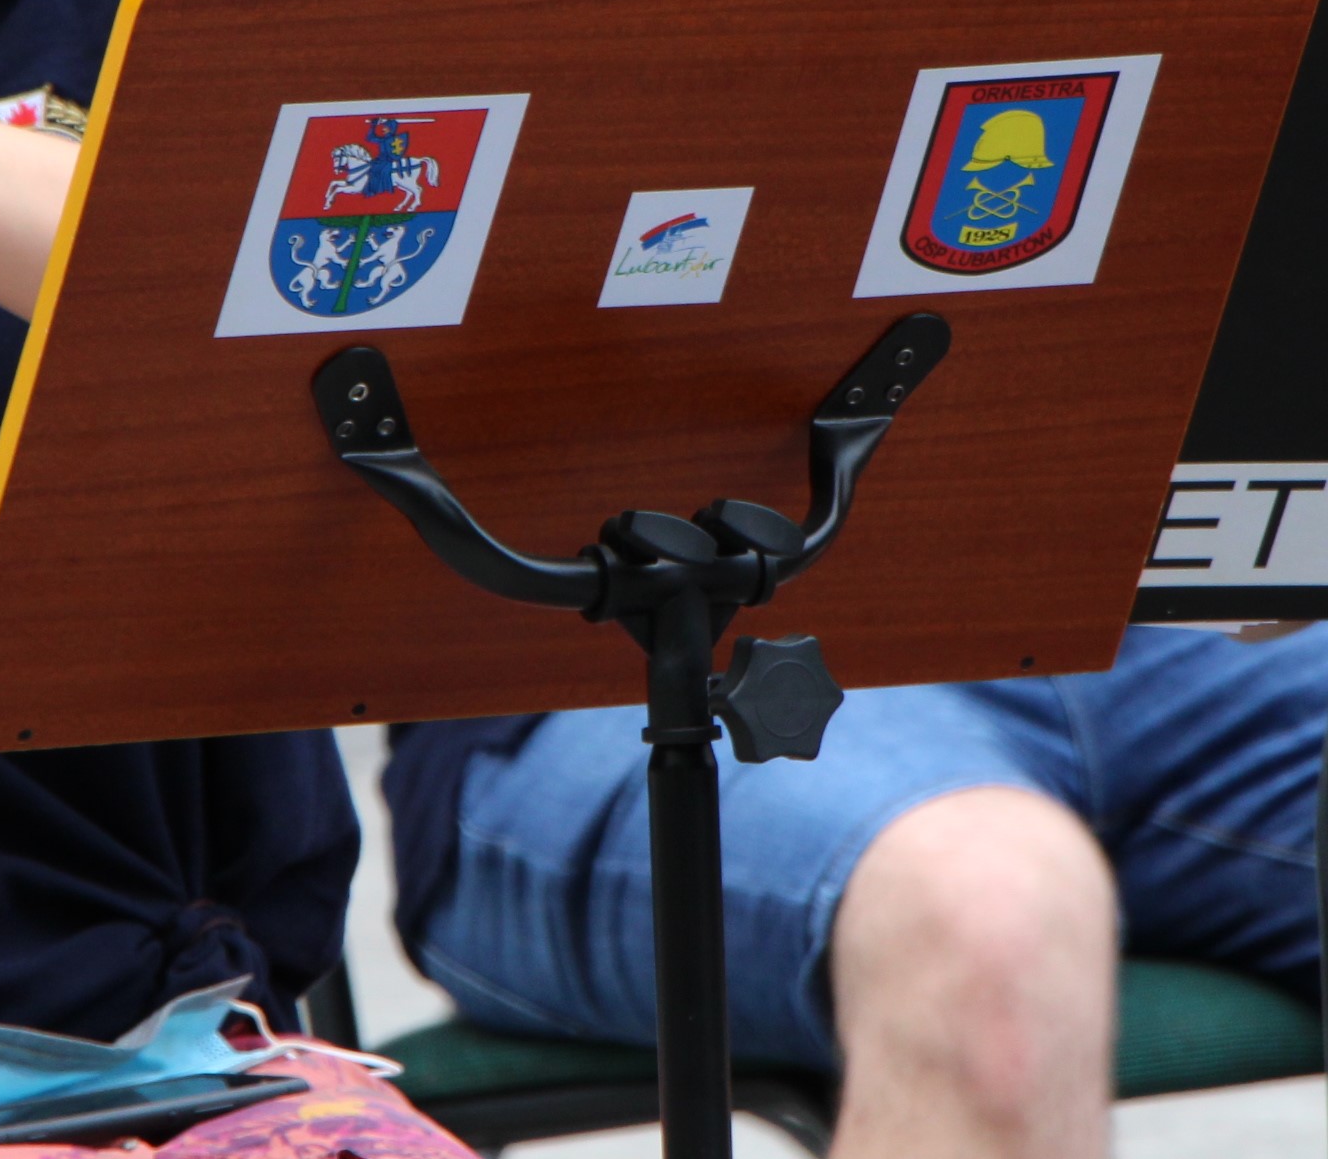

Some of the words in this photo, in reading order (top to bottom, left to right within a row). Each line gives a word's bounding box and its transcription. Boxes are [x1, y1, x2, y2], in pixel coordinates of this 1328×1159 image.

[971, 80, 1086, 103] ORKIESTRA
[914, 235, 948, 259] OSP
[964, 227, 1011, 244] 1928
